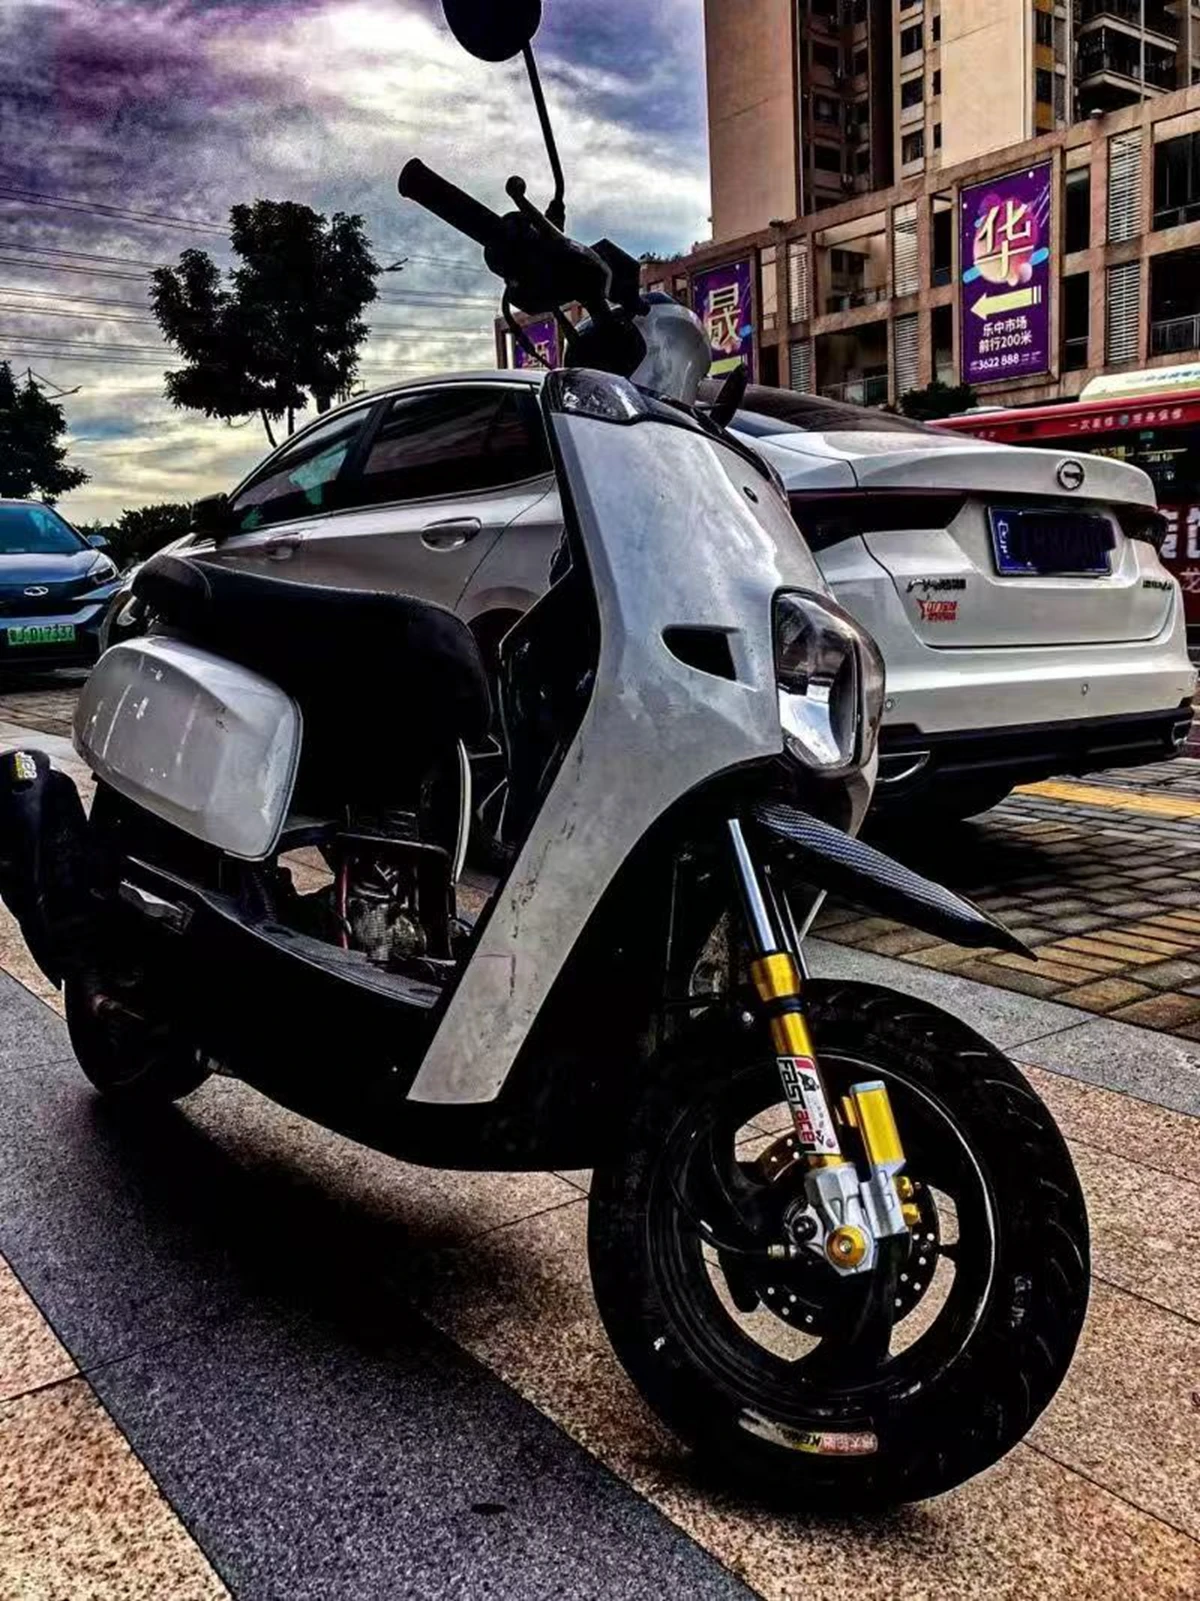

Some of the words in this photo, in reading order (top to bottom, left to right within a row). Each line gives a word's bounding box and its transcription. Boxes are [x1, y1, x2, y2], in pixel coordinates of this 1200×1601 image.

[975, 200, 1034, 279] 华
[708, 283, 743, 350] 晟
[983, 316, 1027, 336] 乐中市场
[979, 331, 1032, 353] 前行200米
